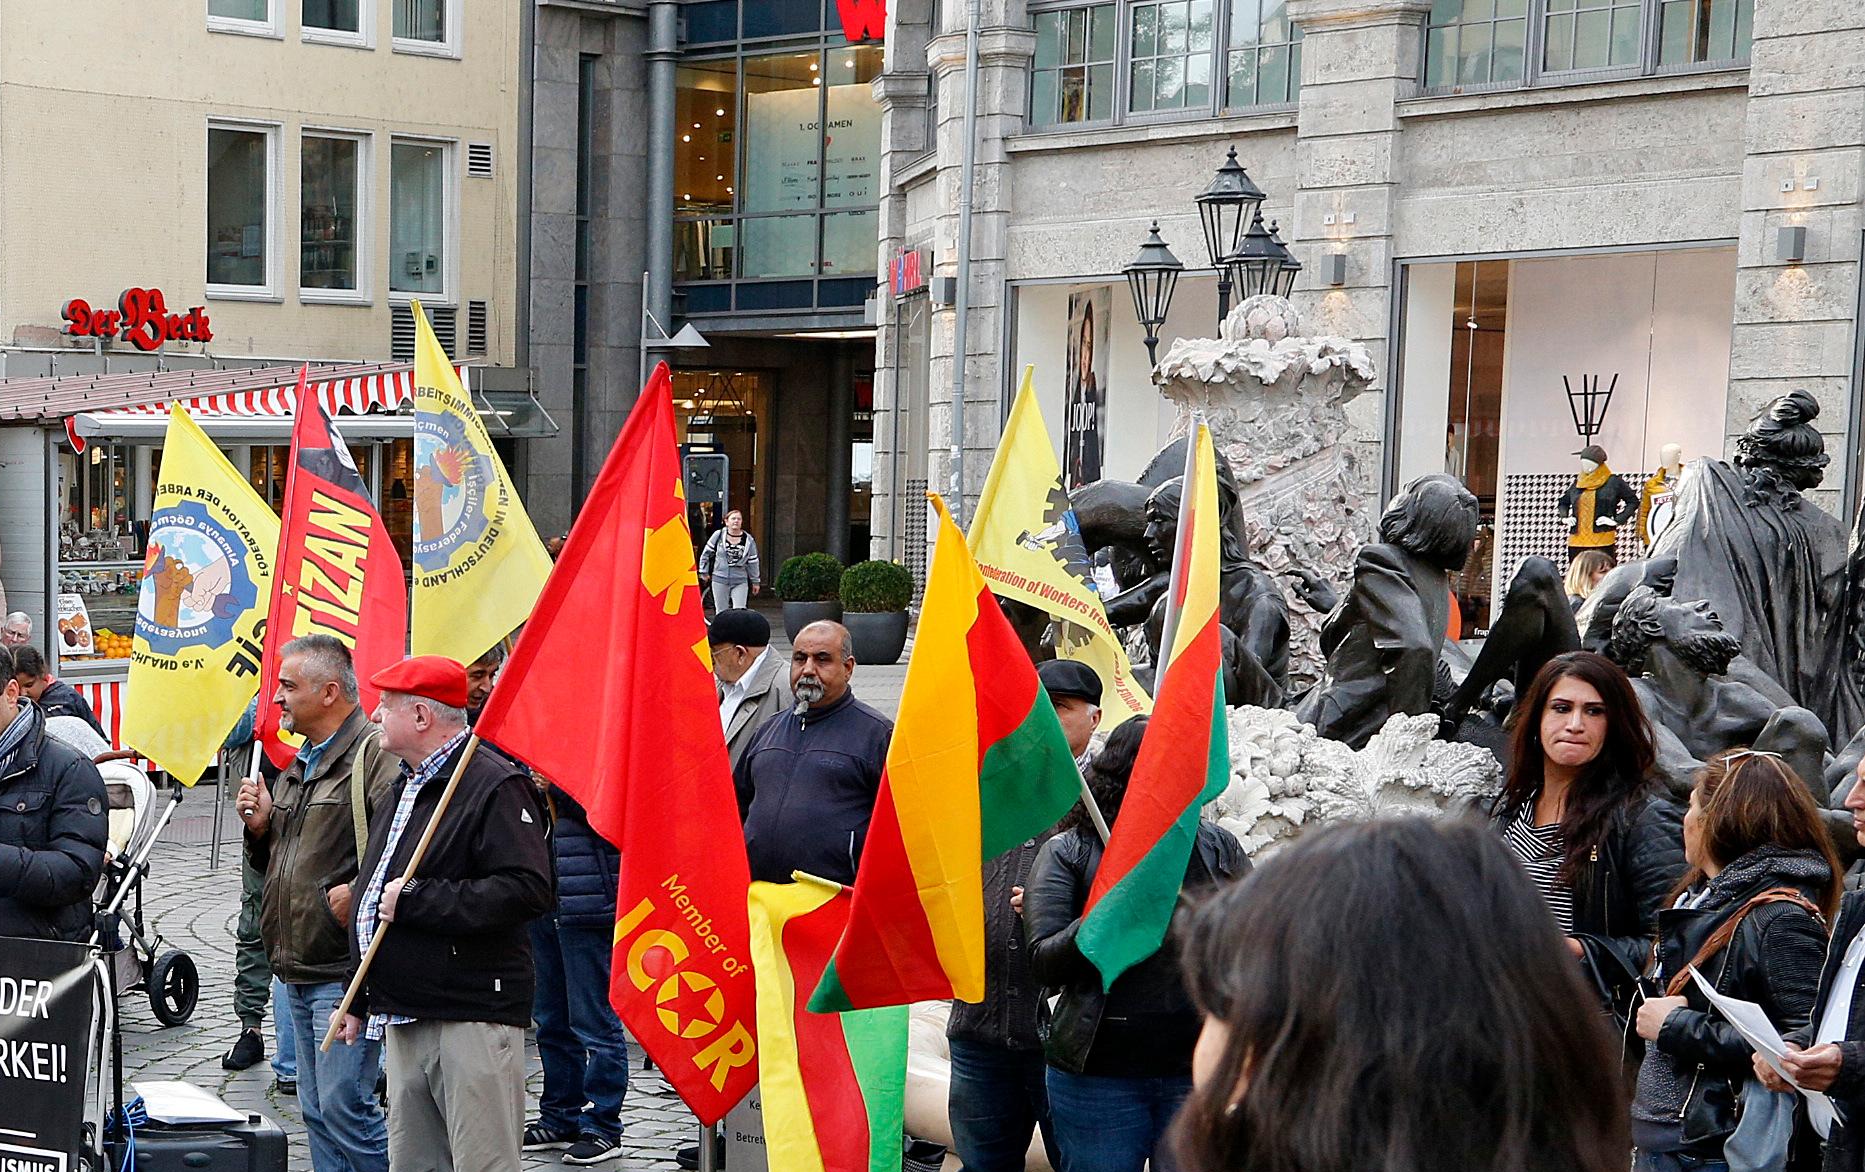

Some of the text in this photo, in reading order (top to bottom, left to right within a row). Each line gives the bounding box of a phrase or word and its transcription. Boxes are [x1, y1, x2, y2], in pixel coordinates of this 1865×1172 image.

[827, 119, 853, 129] AMEN
[60, 287, 214, 351] Der Beck
[1071, 401, 1096, 432] JOOP!
[1027, 580, 1041, 595] of
[1038, 583, 1090, 614] Workers
[661, 873, 749, 978] Member of
